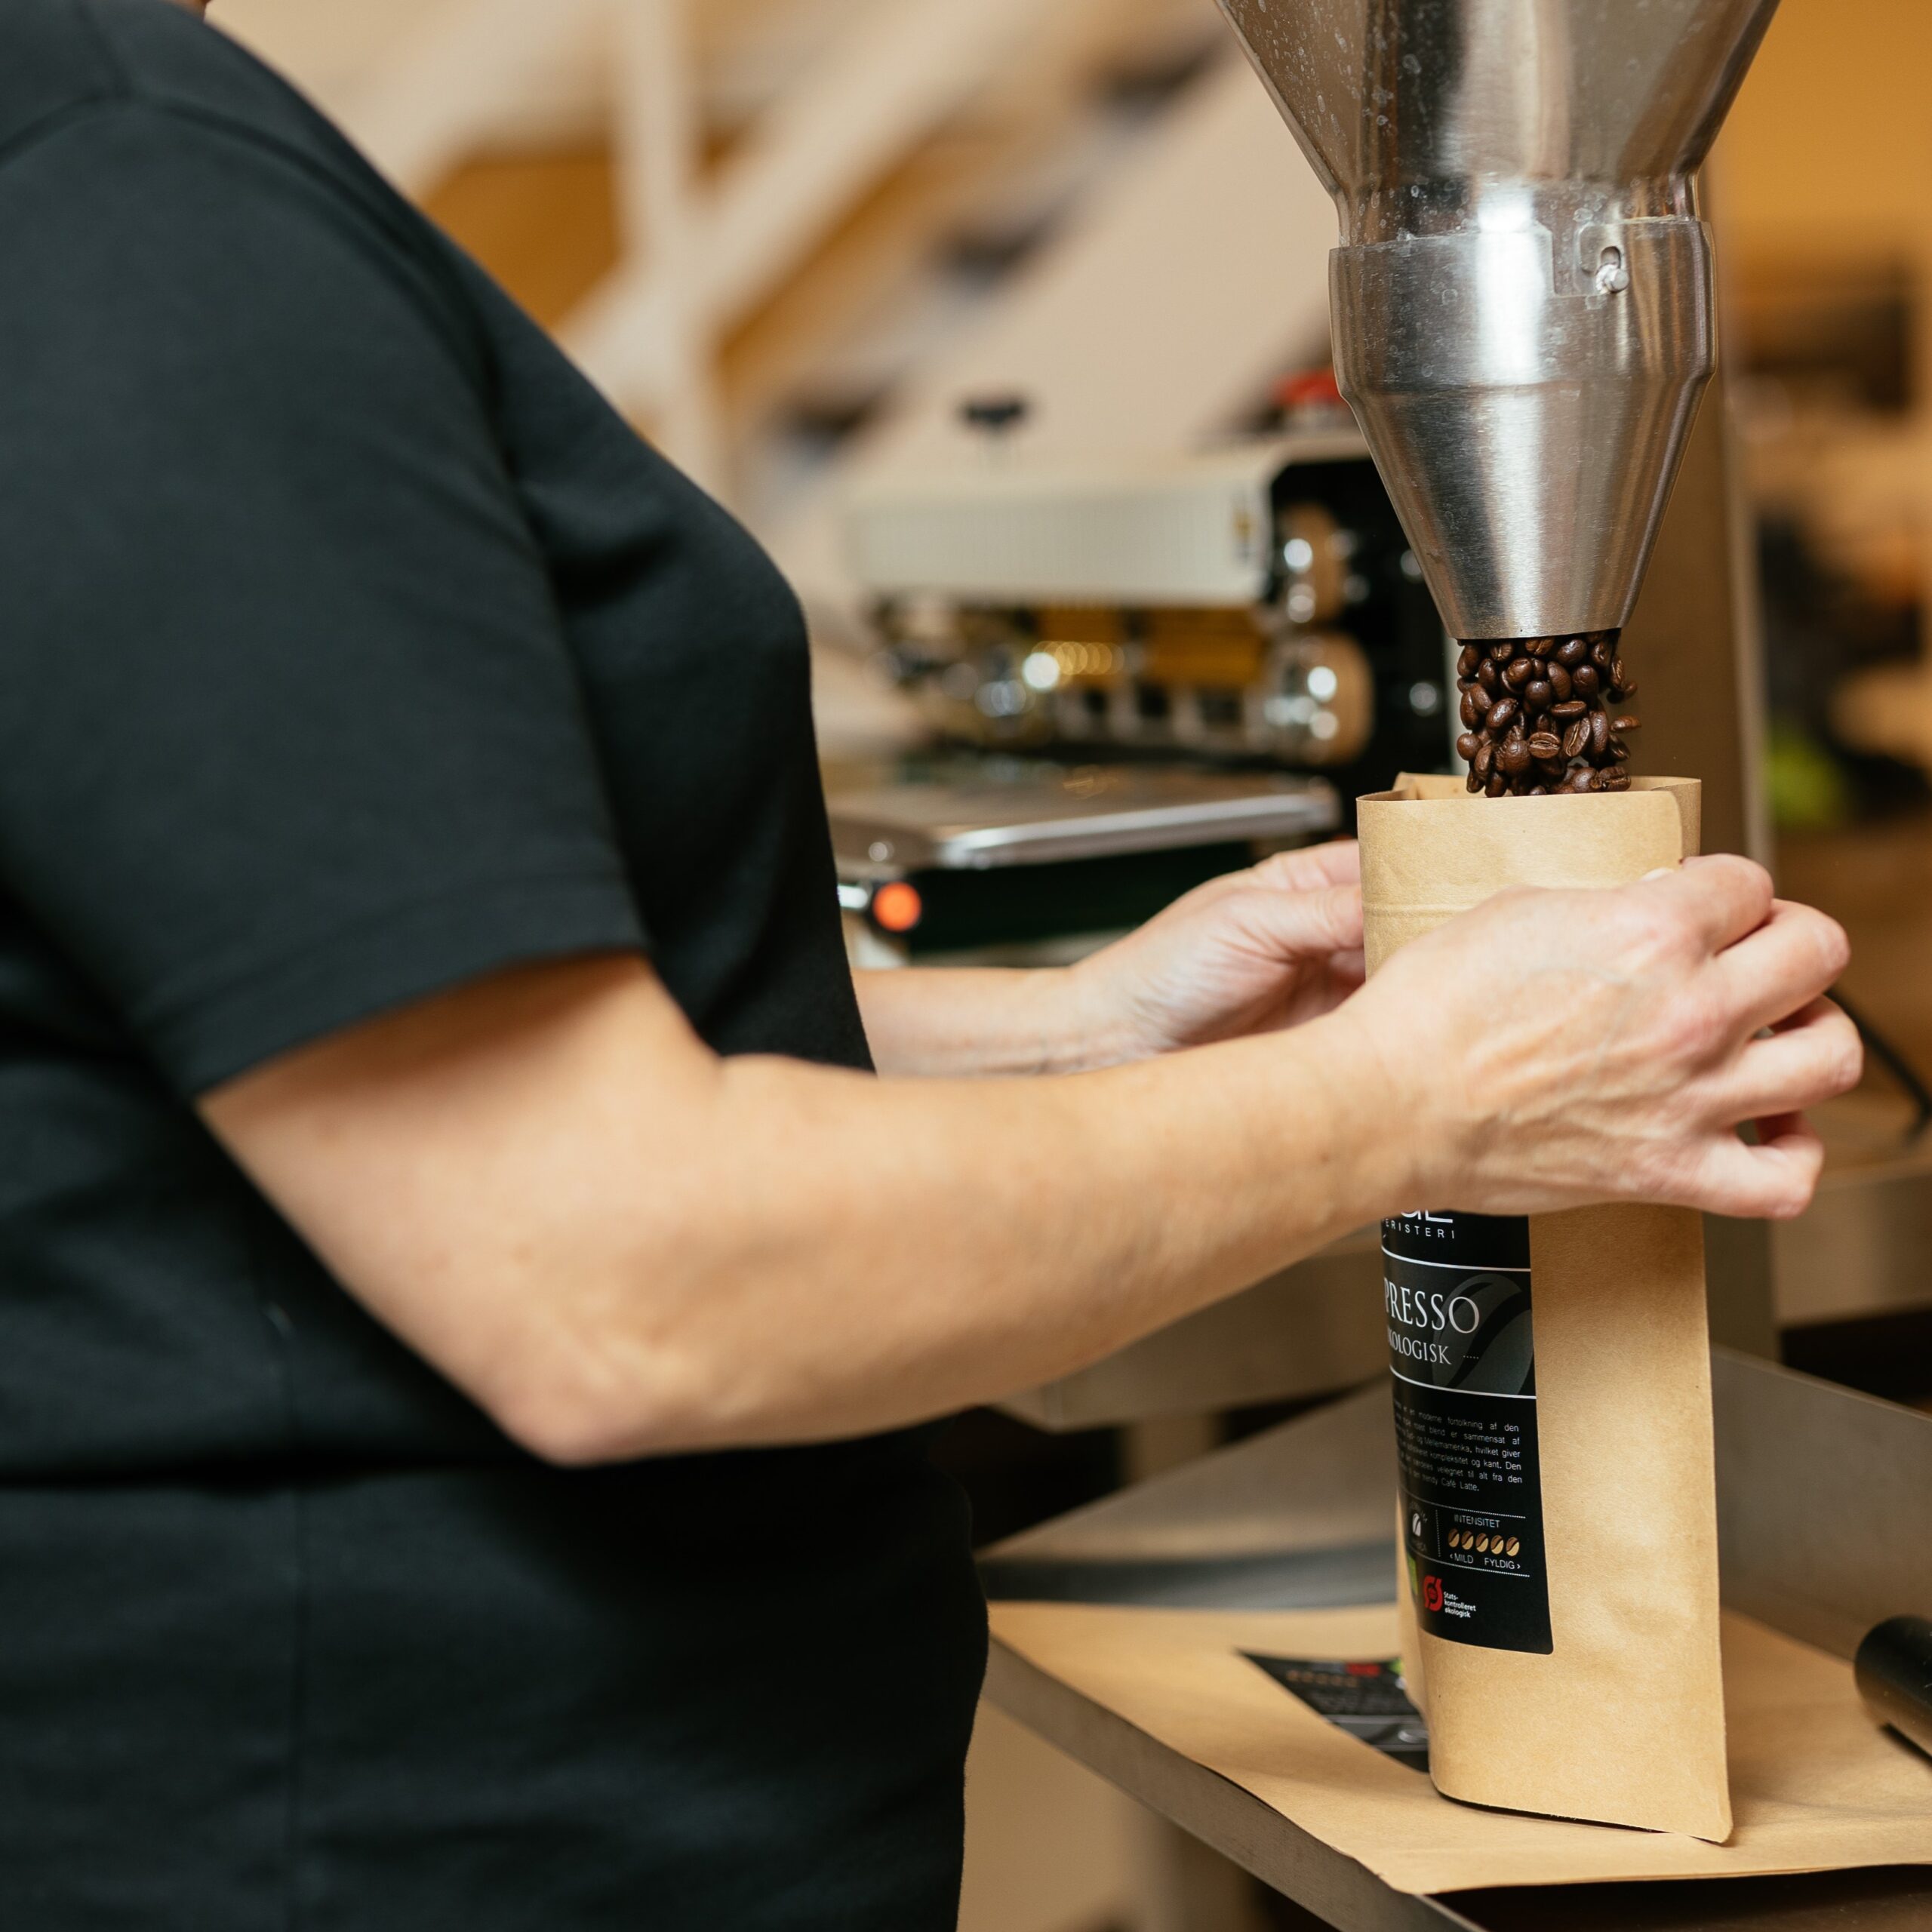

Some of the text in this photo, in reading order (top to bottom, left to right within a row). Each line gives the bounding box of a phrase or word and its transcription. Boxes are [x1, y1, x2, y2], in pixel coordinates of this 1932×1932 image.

[1383, 1218, 1455, 1239] ERISTERI
[1384, 1276, 1480, 1334] PRESSO
[1447, 1417, 1483, 1431] fortolkning
[1490, 1423, 1497, 1431] af
[1504, 1423, 1519, 1432] den
[1463, 1432, 1506, 1444] sammensat
[1512, 1437, 1521, 1446] af
[1475, 1446, 1499, 1457] hvilket
[1502, 1449, 1521, 1459] giver
[1472, 1458, 1481, 1467] og
[1484, 1459, 1502, 1469] kant.
[1505, 1461, 1521, 1471] Den
[1437, 1465, 1463, 1477] velegnet
[1479, 1472, 1488, 1481] alt
[1492, 1472, 1503, 1481] fra
[1507, 1474, 1523, 1484] den
[1441, 1478, 1457, 1488] Café
[1460, 1481, 1480, 1492] Latte.
[1454, 1515, 1500, 1528] INTENSITET
[1454, 1552, 1515, 1570] MILD FYLDIG
[1444, 1591, 1459, 1601] Stats-
[1444, 1599, 1476, 1612] kontrolleret
[1444, 1607, 1471, 1618] økologisk
